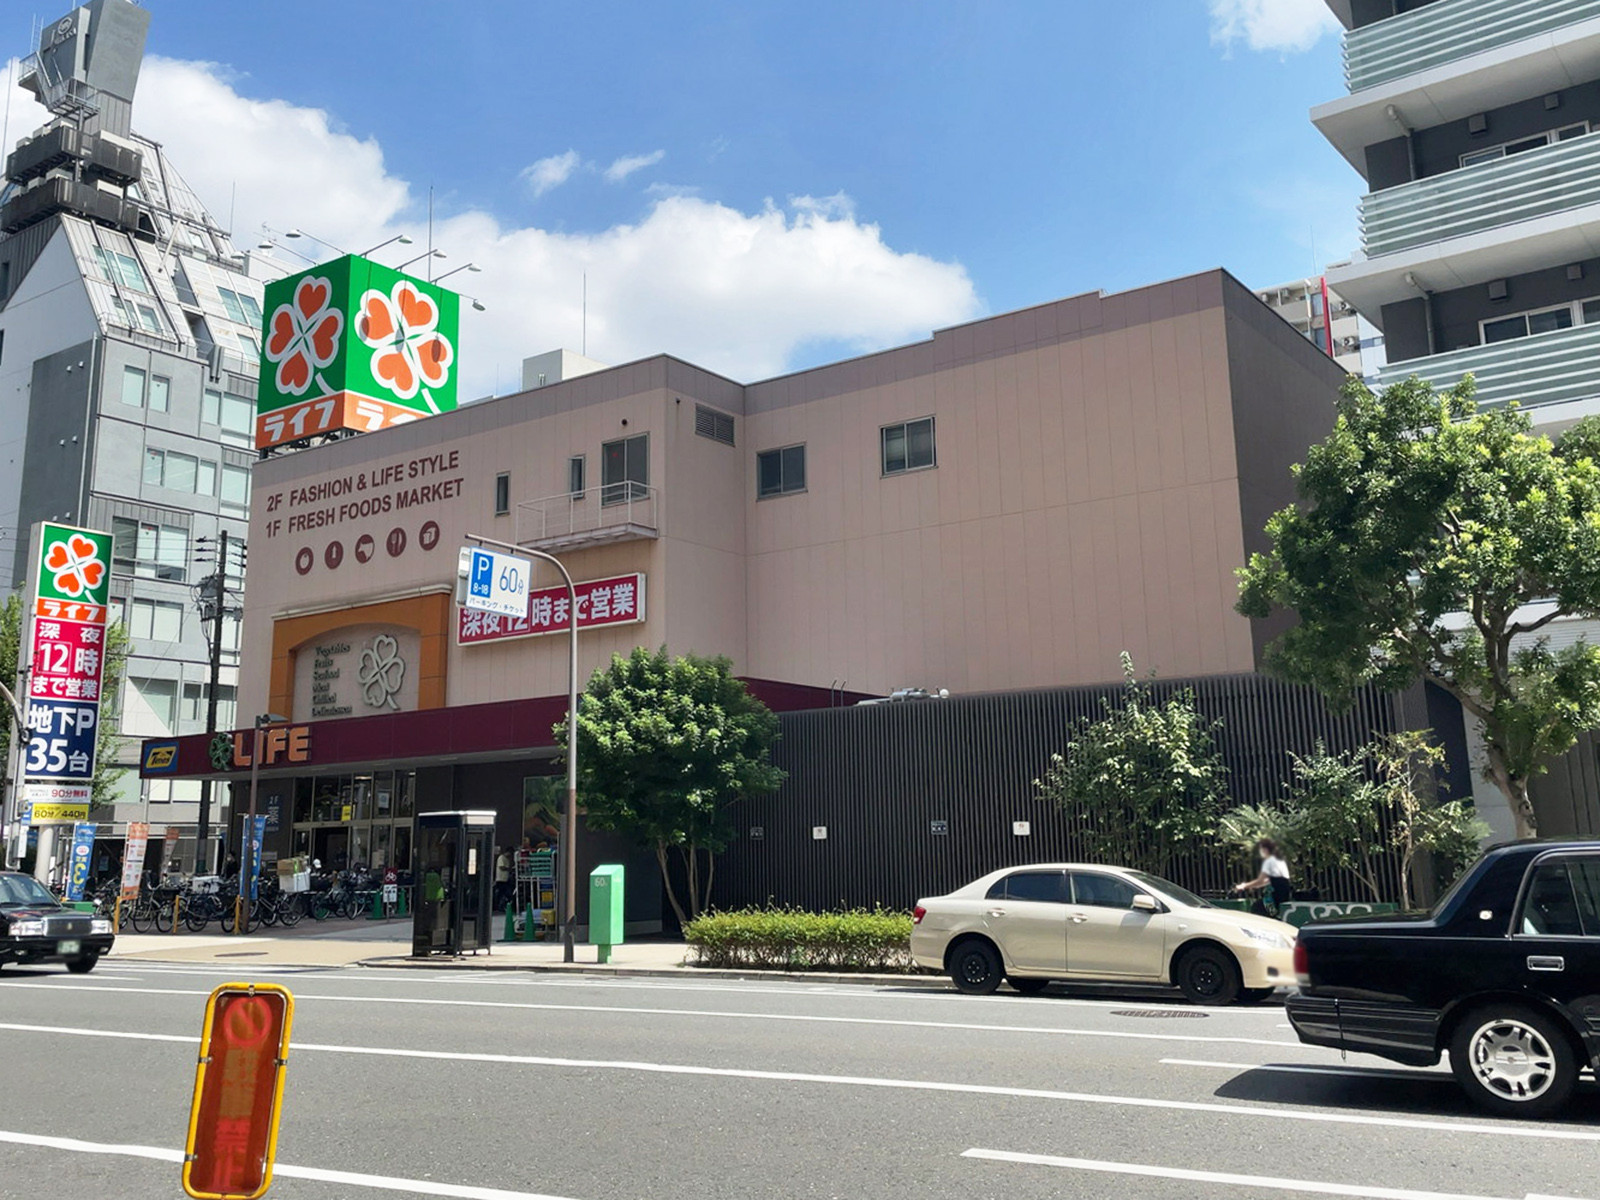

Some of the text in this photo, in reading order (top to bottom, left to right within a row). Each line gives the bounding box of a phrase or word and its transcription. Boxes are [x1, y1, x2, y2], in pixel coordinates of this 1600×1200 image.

[264, 400, 335, 442] ライフ
[266, 450, 459, 512] 2F FASHION & LIFE STYLE
[265, 478, 464, 538] 1F FRESH FOODS MARKET
[478, 556, 490, 580] P
[500, 566, 524, 595] 60分
[473, 582, 489, 595] 8-18
[43, 601, 99, 620] ライフ
[40, 642, 99, 676] 12時
[32, 676, 97, 698] まで営業
[28, 704, 94, 736] 地下P
[26, 737, 89, 772] 35台
[233, 726, 309, 766] LIFE
